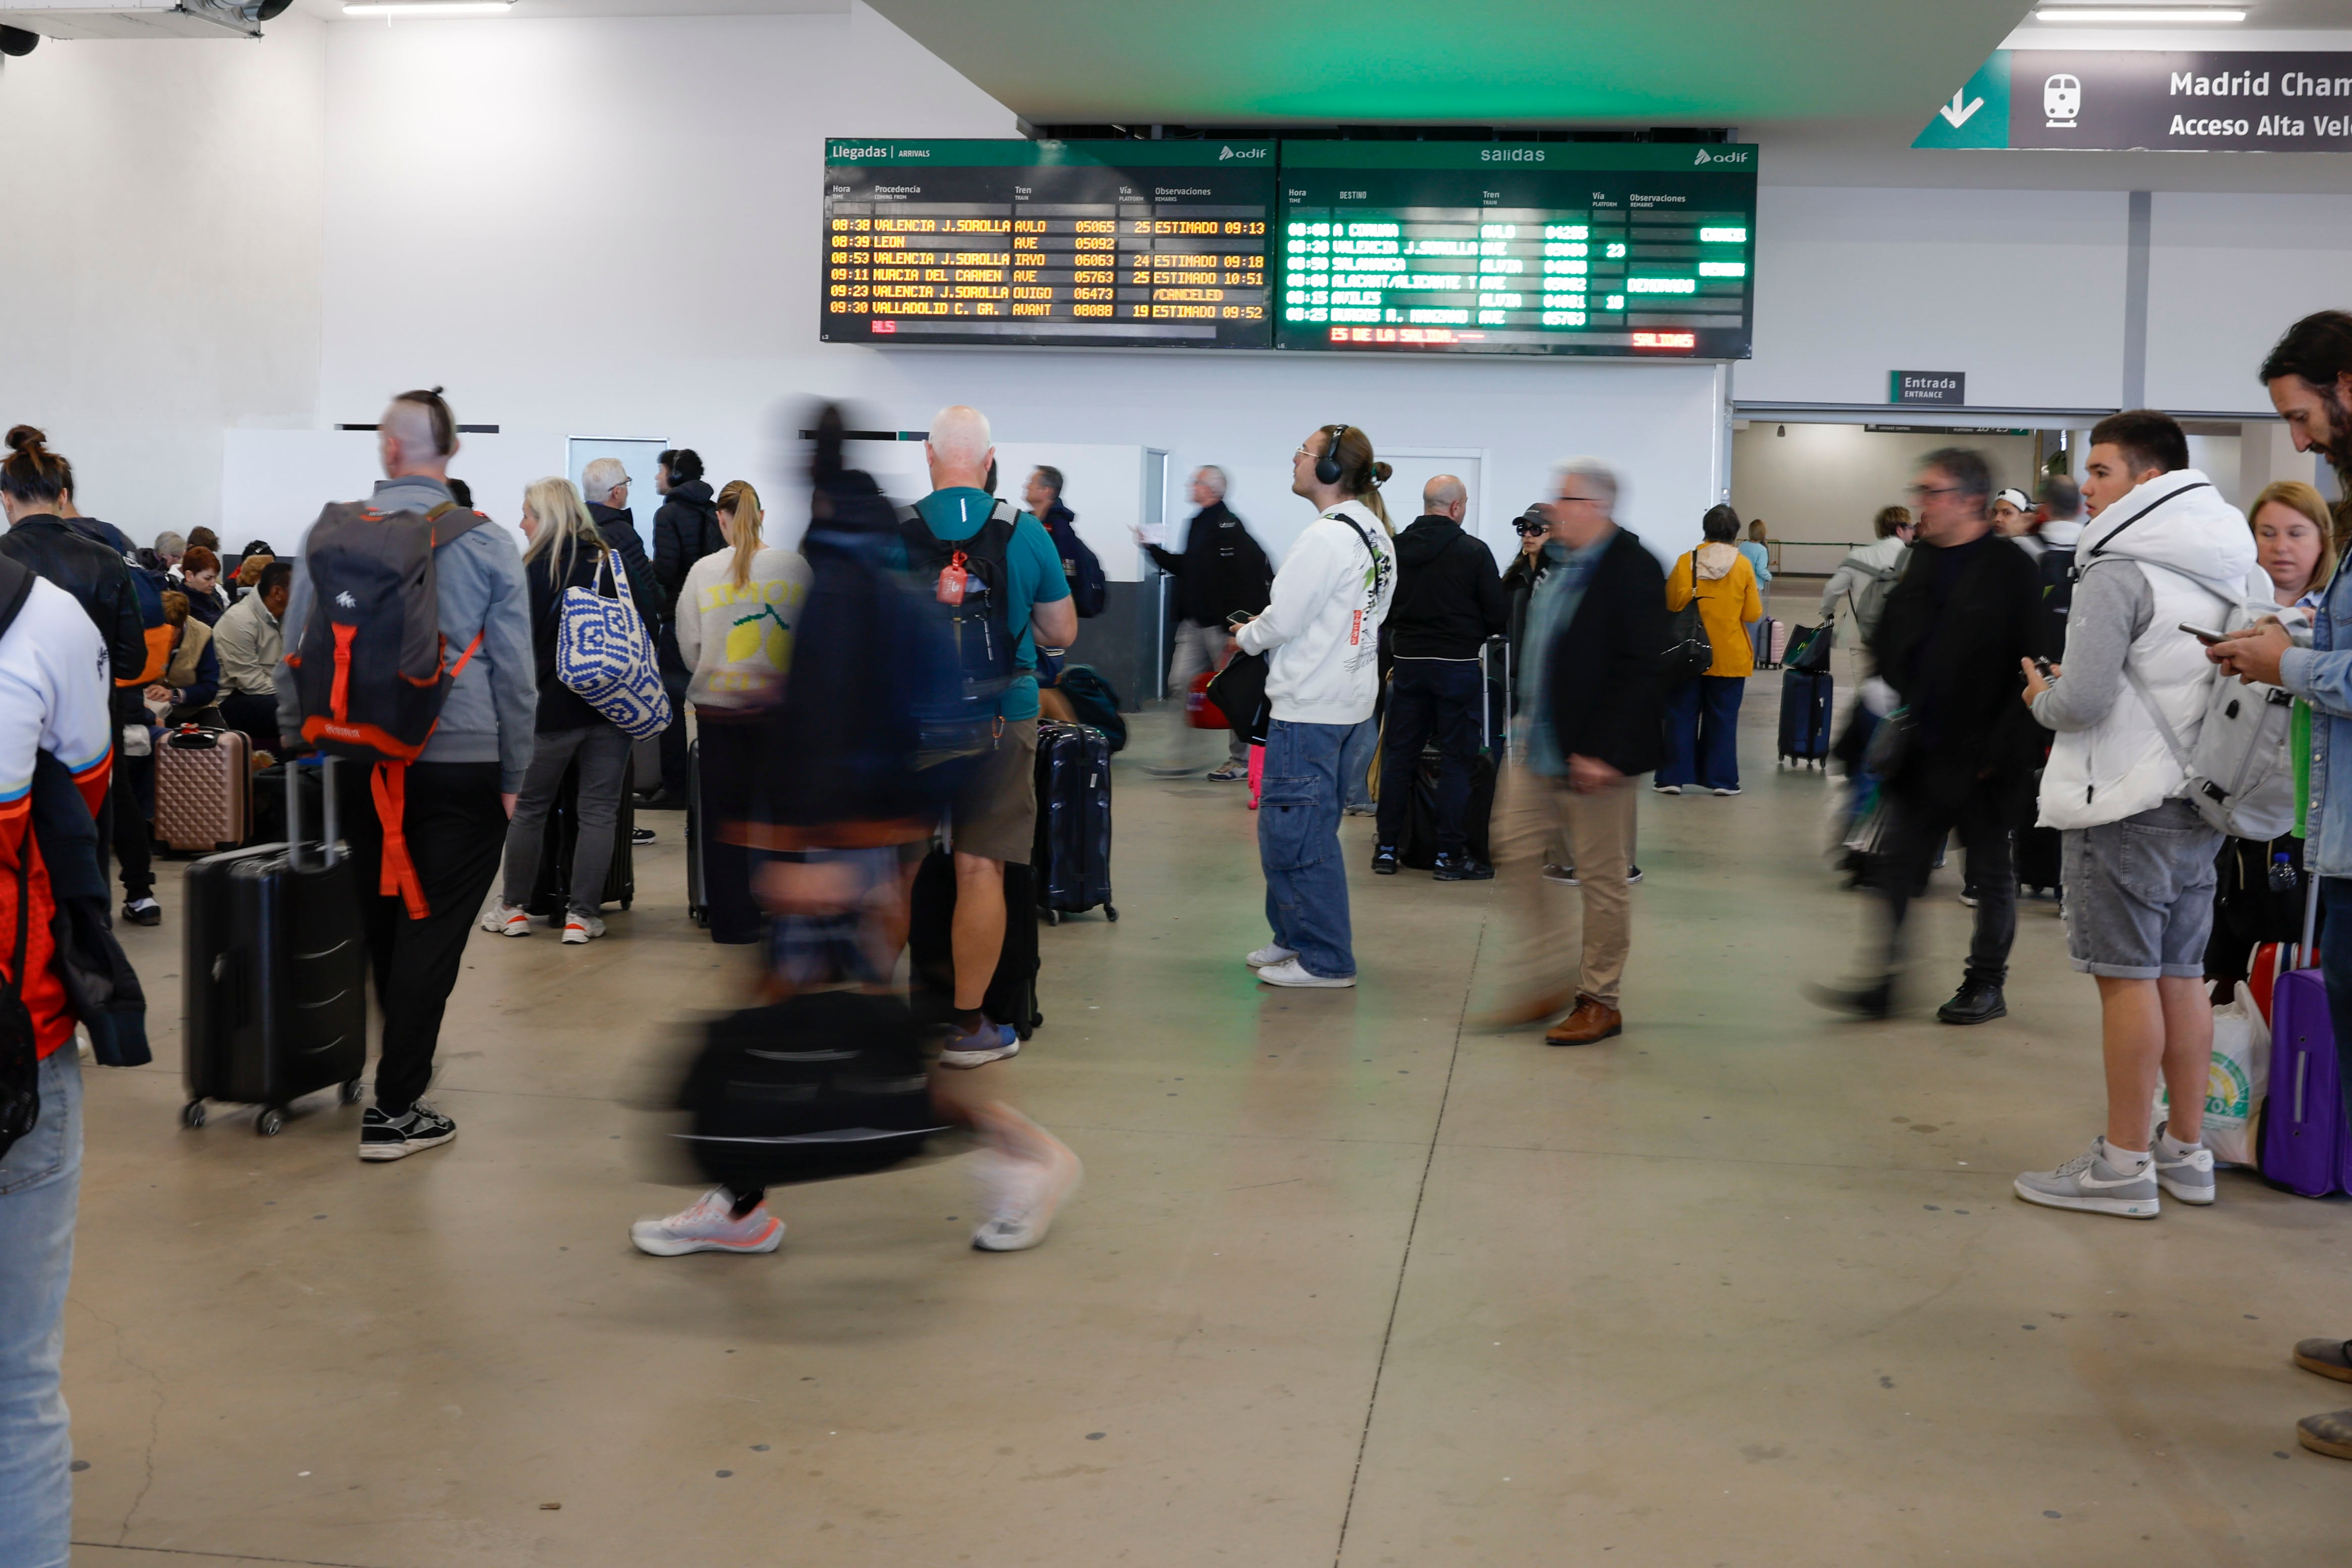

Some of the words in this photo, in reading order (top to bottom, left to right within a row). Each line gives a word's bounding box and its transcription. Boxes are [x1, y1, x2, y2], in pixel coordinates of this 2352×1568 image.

[2170, 70, 2270, 96] Madrid
[2281, 72, 2352, 96] Cham
[2169, 115, 2249, 136] Acceso
[2257, 115, 2305, 136] Alta
[2313, 115, 2352, 136] Vel
[833, 145, 887, 160] Llegadas
[1236, 149, 1267, 158] adif
[1481, 149, 1545, 162] salidas
[1713, 152, 1749, 163] adif
[1119, 186, 1132, 194] Vía
[1155, 187, 1211, 195] Observaciones
[1340, 191, 1367, 199] DESTINO
[1630, 194, 1686, 203] Observaciones
[832, 219, 871, 231] 08:38
[874, 219, 935, 232] VALENCIA
[942, 220, 1011, 232] J.SOROLLA
[1014, 220, 1047, 233] AVLO
[1075, 220, 1116, 233] 05065
[1134, 221, 1151, 233] 25
[1154, 221, 1218, 234] ESTIMADO
[1224, 222, 1265, 234] 09:13
[831, 235, 870, 248] 08:39
[873, 236, 906, 248] LEON
[1014, 237, 1039, 250] AVE
[1074, 237, 1115, 250] 05092
[1333, 240, 1399, 255] VALENCIA
[831, 252, 870, 264] 08:53
[873, 252, 935, 265] VALENCIA
[941, 253, 1010, 265] J.SOROLLA
[1014, 254, 1046, 266] IRYO
[1074, 254, 1114, 267] 06063
[1133, 254, 1150, 267] 24
[1154, 255, 1217, 267] ESTIMADO
[1223, 256, 1264, 268] 09:18
[831, 268, 869, 280] 09:11
[873, 269, 919, 281] MURCIA
[925, 269, 949, 281] DEL
[955, 270, 1002, 282] CARMEN
[1013, 270, 1038, 283] AVE
[1074, 271, 1114, 283] 05763
[1133, 271, 1151, 283] 25
[1153, 272, 1217, 284] ESTIMADO
[1224, 272, 1263, 285] 10:51
[830, 285, 869, 297] 09:23
[872, 285, 934, 298] VALENCIA
[940, 286, 1009, 299] J.SOROLLA
[1013, 287, 1053, 300] OUIGO
[1073, 287, 1114, 300] 06473
[830, 301, 869, 313] 09:30
[872, 302, 949, 314] VALLADOLID
[954, 303, 969, 315] C.
[977, 303, 1000, 315] GR.
[1012, 304, 1052, 316] AVANT
[1073, 304, 1113, 317] 08088
[1133, 305, 1149, 317] 19
[1152, 305, 1216, 318] ESTIMADO
[1222, 306, 1262, 318] 09:52
[1352, 328, 1373, 342] DE
[1376, 328, 1395, 342] LA
[1904, 377, 1956, 389] Entrada
[1904, 390, 1943, 399] ENTRANCE
